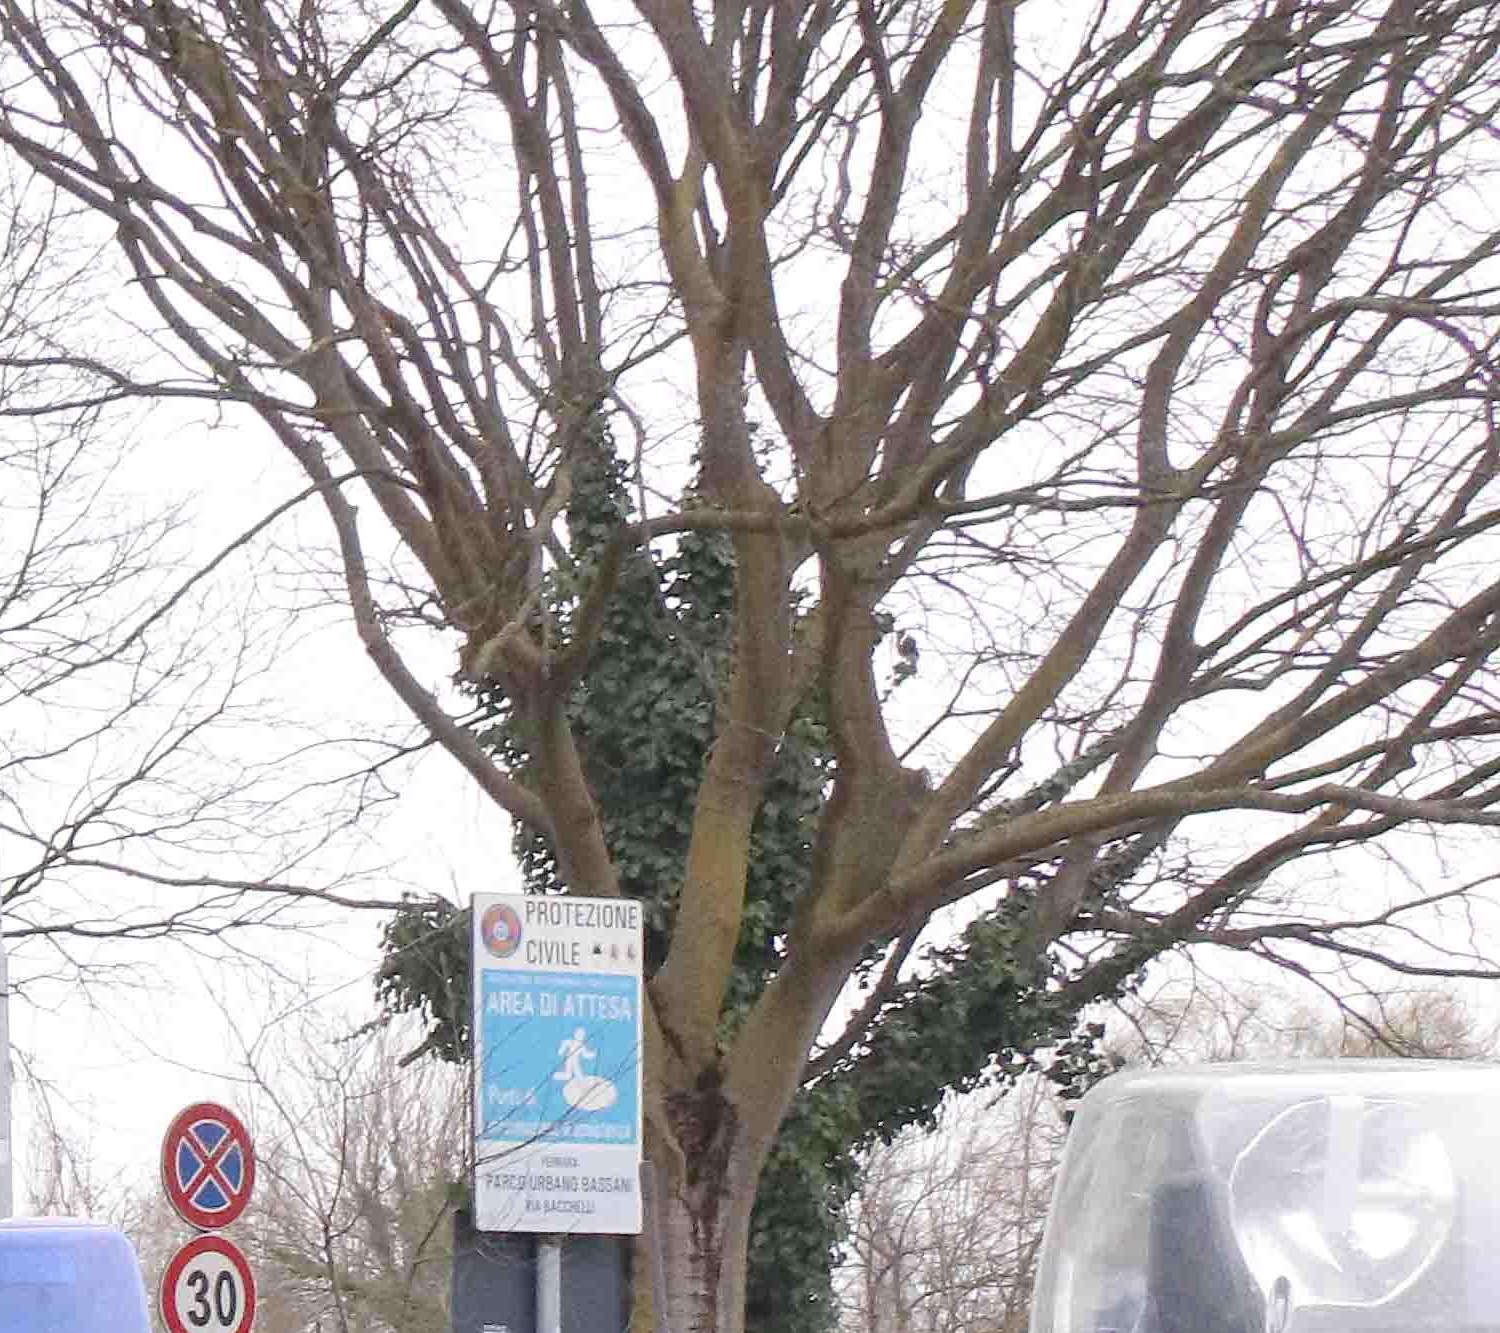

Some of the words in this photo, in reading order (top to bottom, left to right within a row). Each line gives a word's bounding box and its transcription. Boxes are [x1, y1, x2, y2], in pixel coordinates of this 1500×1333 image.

[525, 900, 638, 929] PROTEZIONE
[525, 939, 581, 966] CIVILE
[486, 992, 534, 1016] AREA
[539, 993, 557, 1016] DI
[564, 993, 632, 1020] ATTESA
[530, 1176, 579, 1191] URBANO
[186, 1269, 238, 1328] 30
